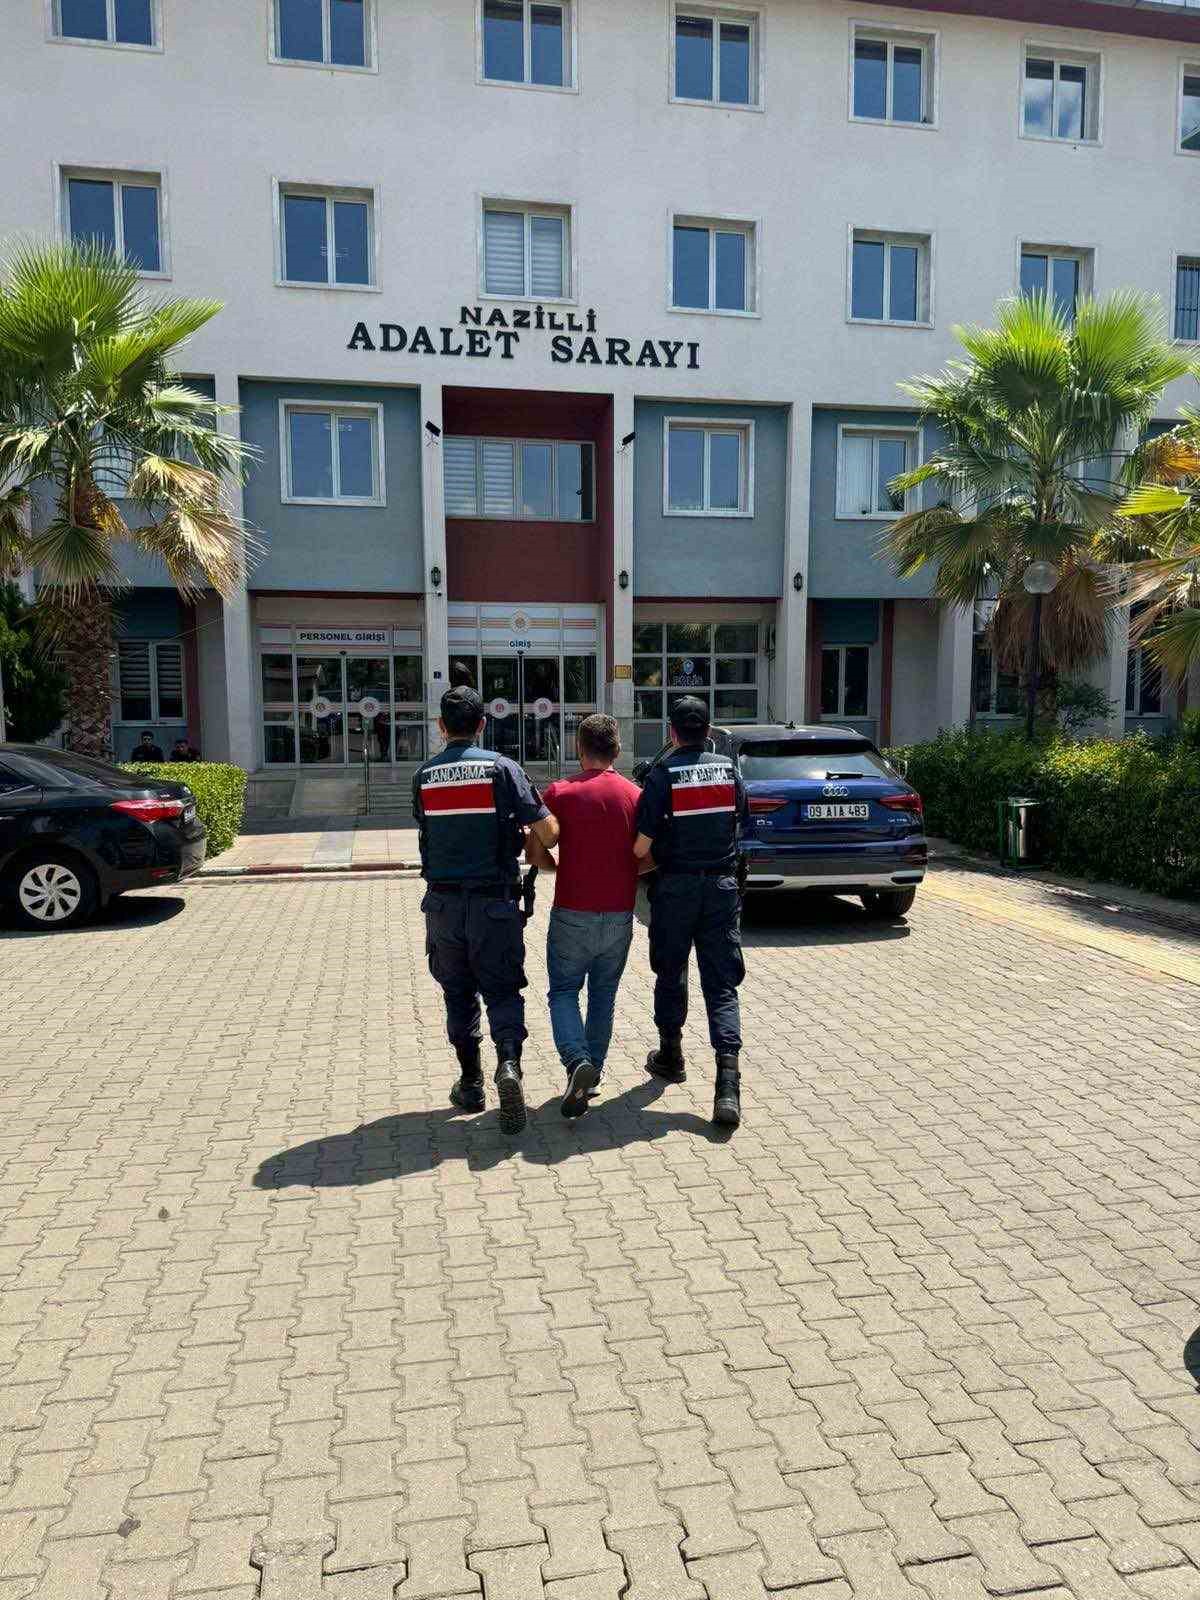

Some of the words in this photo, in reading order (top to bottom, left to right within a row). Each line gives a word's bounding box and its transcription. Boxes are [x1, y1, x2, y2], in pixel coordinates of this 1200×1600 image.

[459, 305, 598, 332] NAZİLLİ
[346, 321, 520, 359] ADALET
[551, 334, 701, 369] SARAYI
[300, 632, 353, 641] PERSONEL
[427, 766, 486, 783] JANDARMA
[678, 768, 728, 784] JANDARMA
[809, 806, 822, 817] 09
[848, 805, 867, 817] 483
